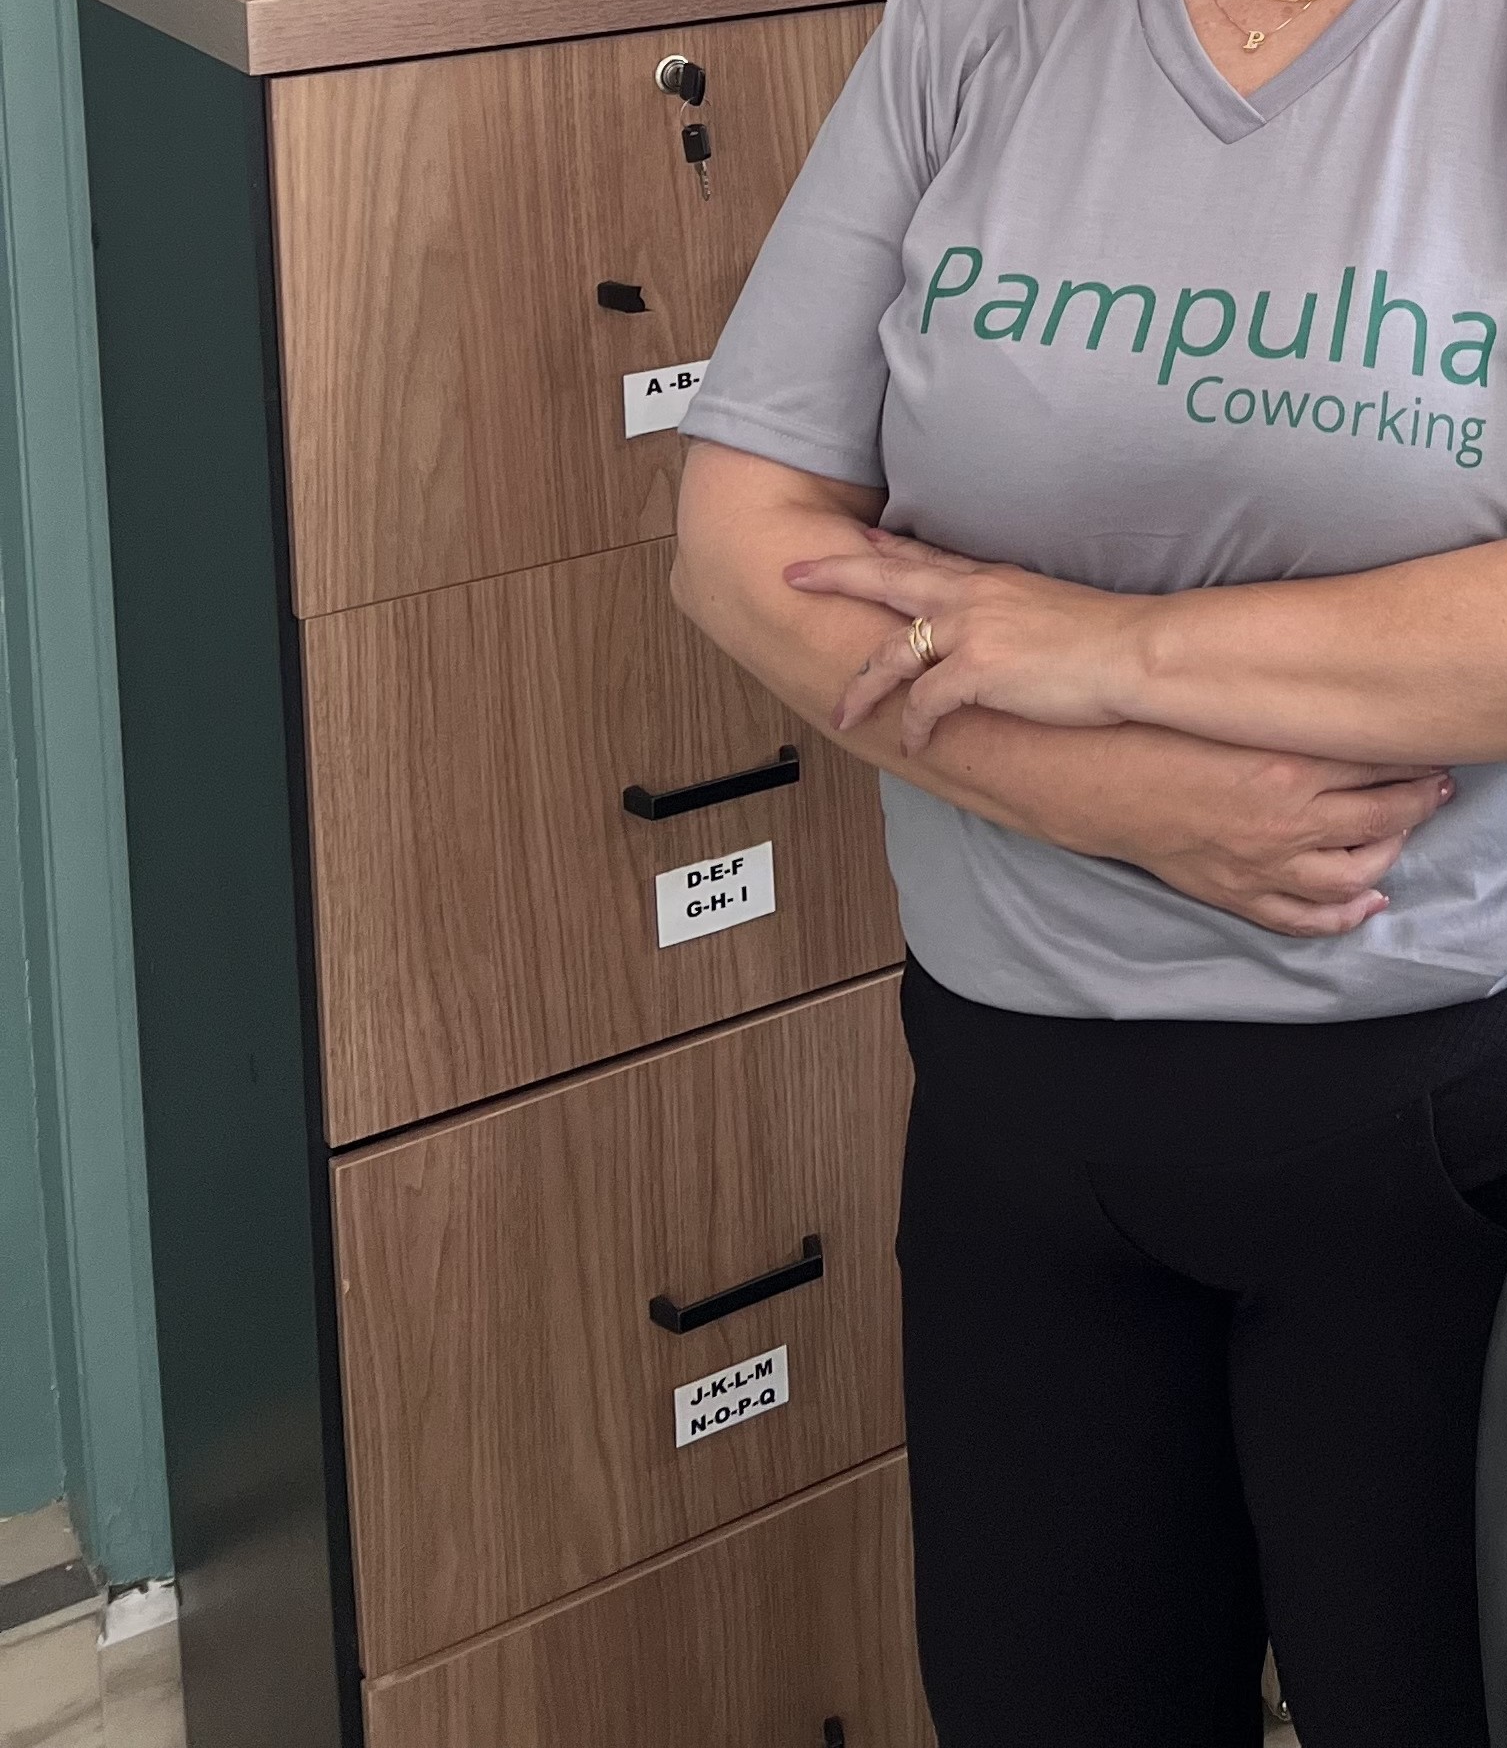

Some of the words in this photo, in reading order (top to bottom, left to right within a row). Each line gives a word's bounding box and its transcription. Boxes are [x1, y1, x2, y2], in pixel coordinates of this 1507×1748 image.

[920, 245, 1498, 388] Pampulha
[645, 378, 663, 396] A
[1185, 375, 1487, 469] Coworking
[687, 857, 744, 888] D-E-F
[690, 1357, 773, 1406] J-K-L-M
[690, 1388, 776, 1436] N-O-P-Q
